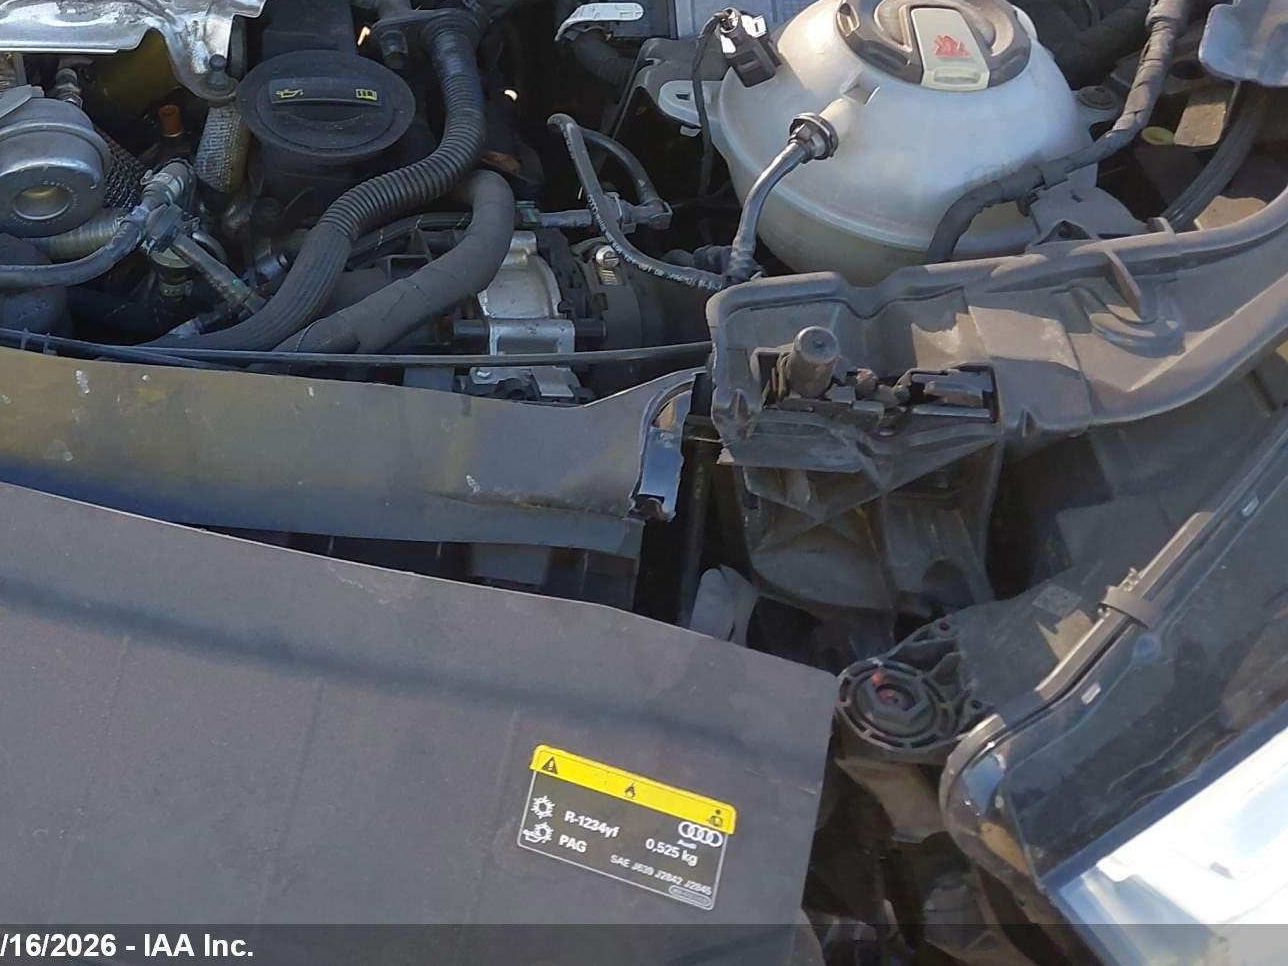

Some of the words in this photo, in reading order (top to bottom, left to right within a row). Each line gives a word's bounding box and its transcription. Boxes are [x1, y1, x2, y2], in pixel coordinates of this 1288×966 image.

[564, 811, 620, 838] R-1234yf
[558, 834, 587, 853] PAG
[645, 839, 679, 859] 0,525
[681, 847, 698, 867] kg
[610, 854, 630, 869] SAE
